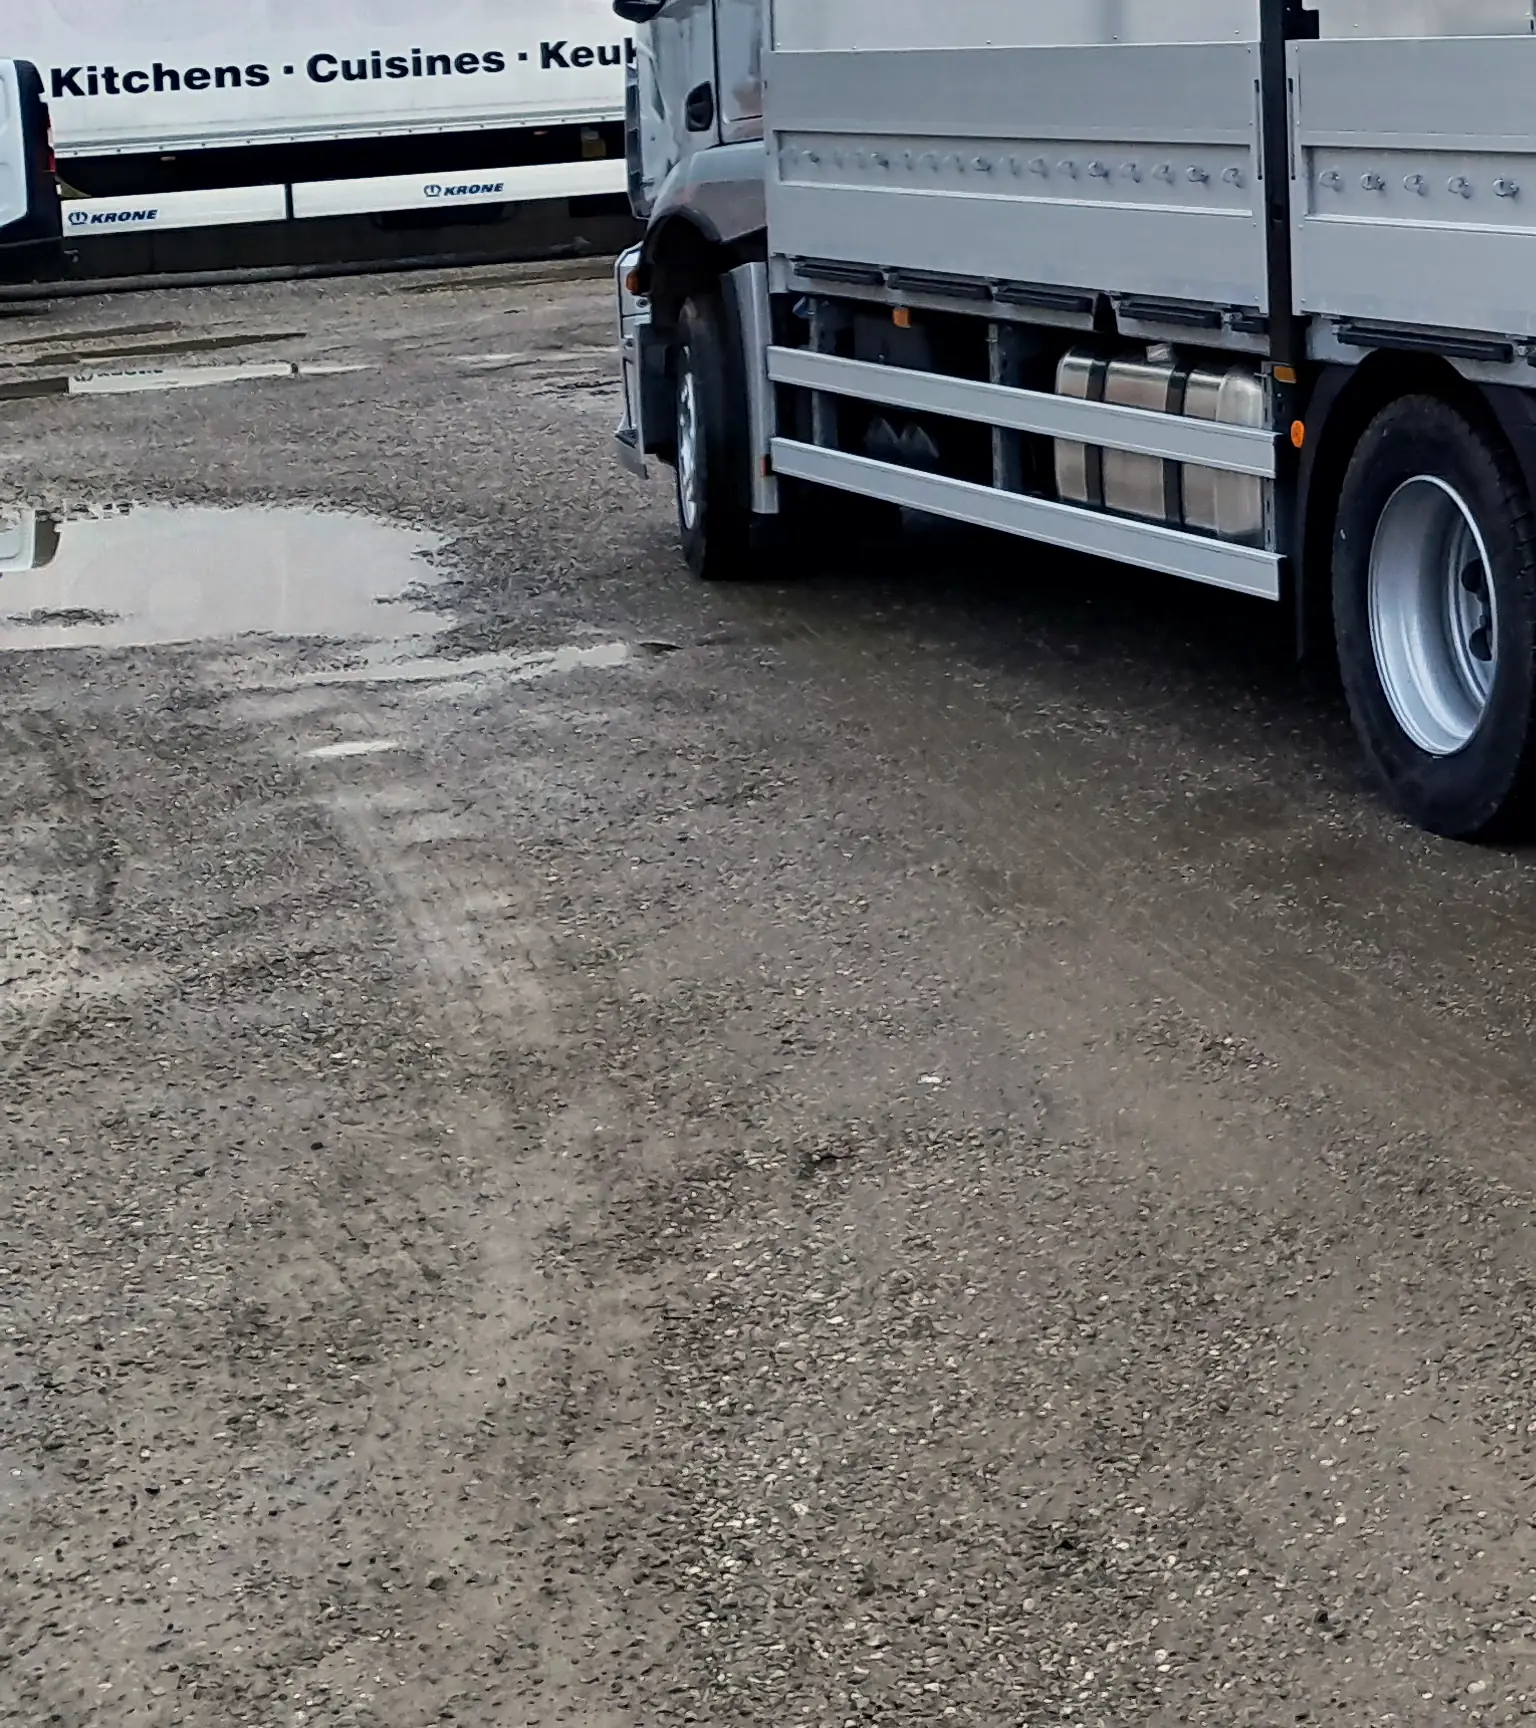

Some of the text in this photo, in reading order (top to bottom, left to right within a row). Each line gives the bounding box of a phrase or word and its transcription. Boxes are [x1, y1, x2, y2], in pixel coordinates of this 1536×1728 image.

[51, 62, 270, 98] Kitchens
[306, 47, 506, 83] Cuisines
[443, 182, 504, 196] KRONE
[90, 209, 158, 224] KRONE
